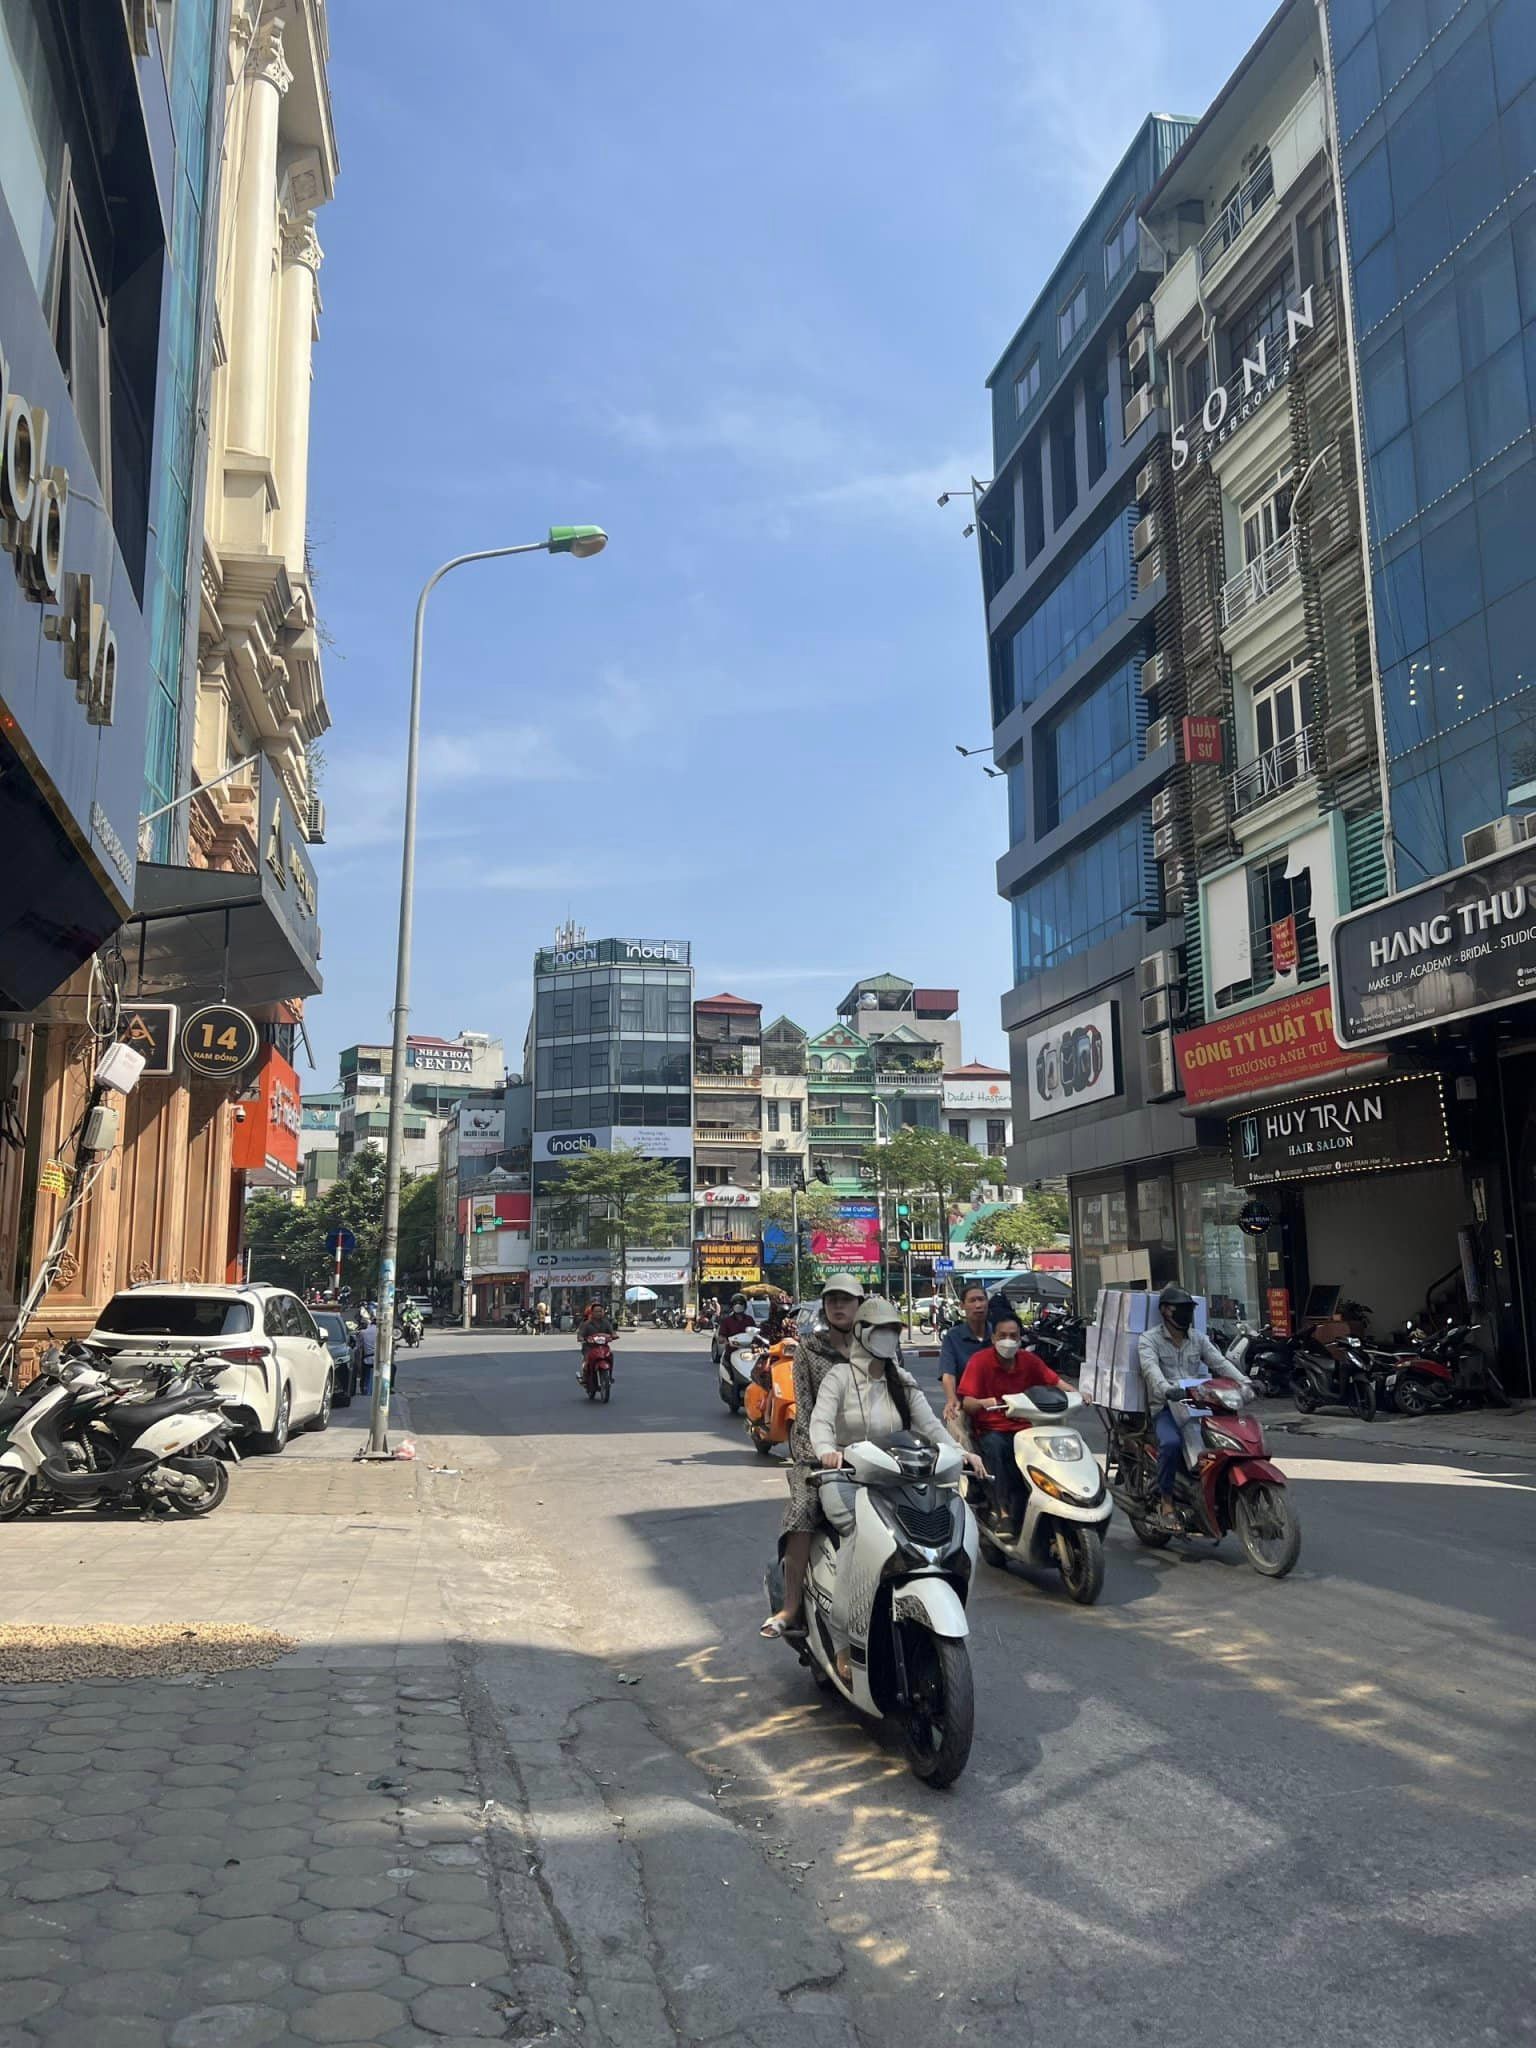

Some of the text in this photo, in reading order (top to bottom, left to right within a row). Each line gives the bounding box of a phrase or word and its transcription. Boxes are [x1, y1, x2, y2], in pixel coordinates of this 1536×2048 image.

[1171, 284, 1314, 471] SONN
[1197, 360, 1290, 464] EYEBROWS
[1369, 886, 1527, 968] HANG THU
[553, 945, 597, 964] inochi
[626, 942, 679, 960] inochi
[1368, 975, 1391, 993] MAKE
[1392, 970, 1403, 985] UP
[1410, 955, 1452, 979] ACADEMY
[1460, 942, 1492, 963] BRIDAL
[202, 1024, 237, 1050] 14
[1184, 1041, 1233, 1070] CÔNG
[1234, 1030, 1257, 1056] TY
[1259, 1014, 1307, 1047] LUẬT
[193, 1051, 212, 1060] NAM
[415, 1057, 446, 1070] SEN
[419, 1048, 469, 1059] NHA KHOA
[1228, 1053, 1277, 1079] TRƯƠNG
[1279, 1046, 1306, 1066] ANH
[1310, 1037, 1328, 1056] TÚ
[1266, 1096, 1383, 1140] HUY TRAN
[552, 1135, 591, 1152] inochi
[1288, 1136, 1354, 1156] HAIR SALON
[1493, 1249, 1502, 1265] 3
